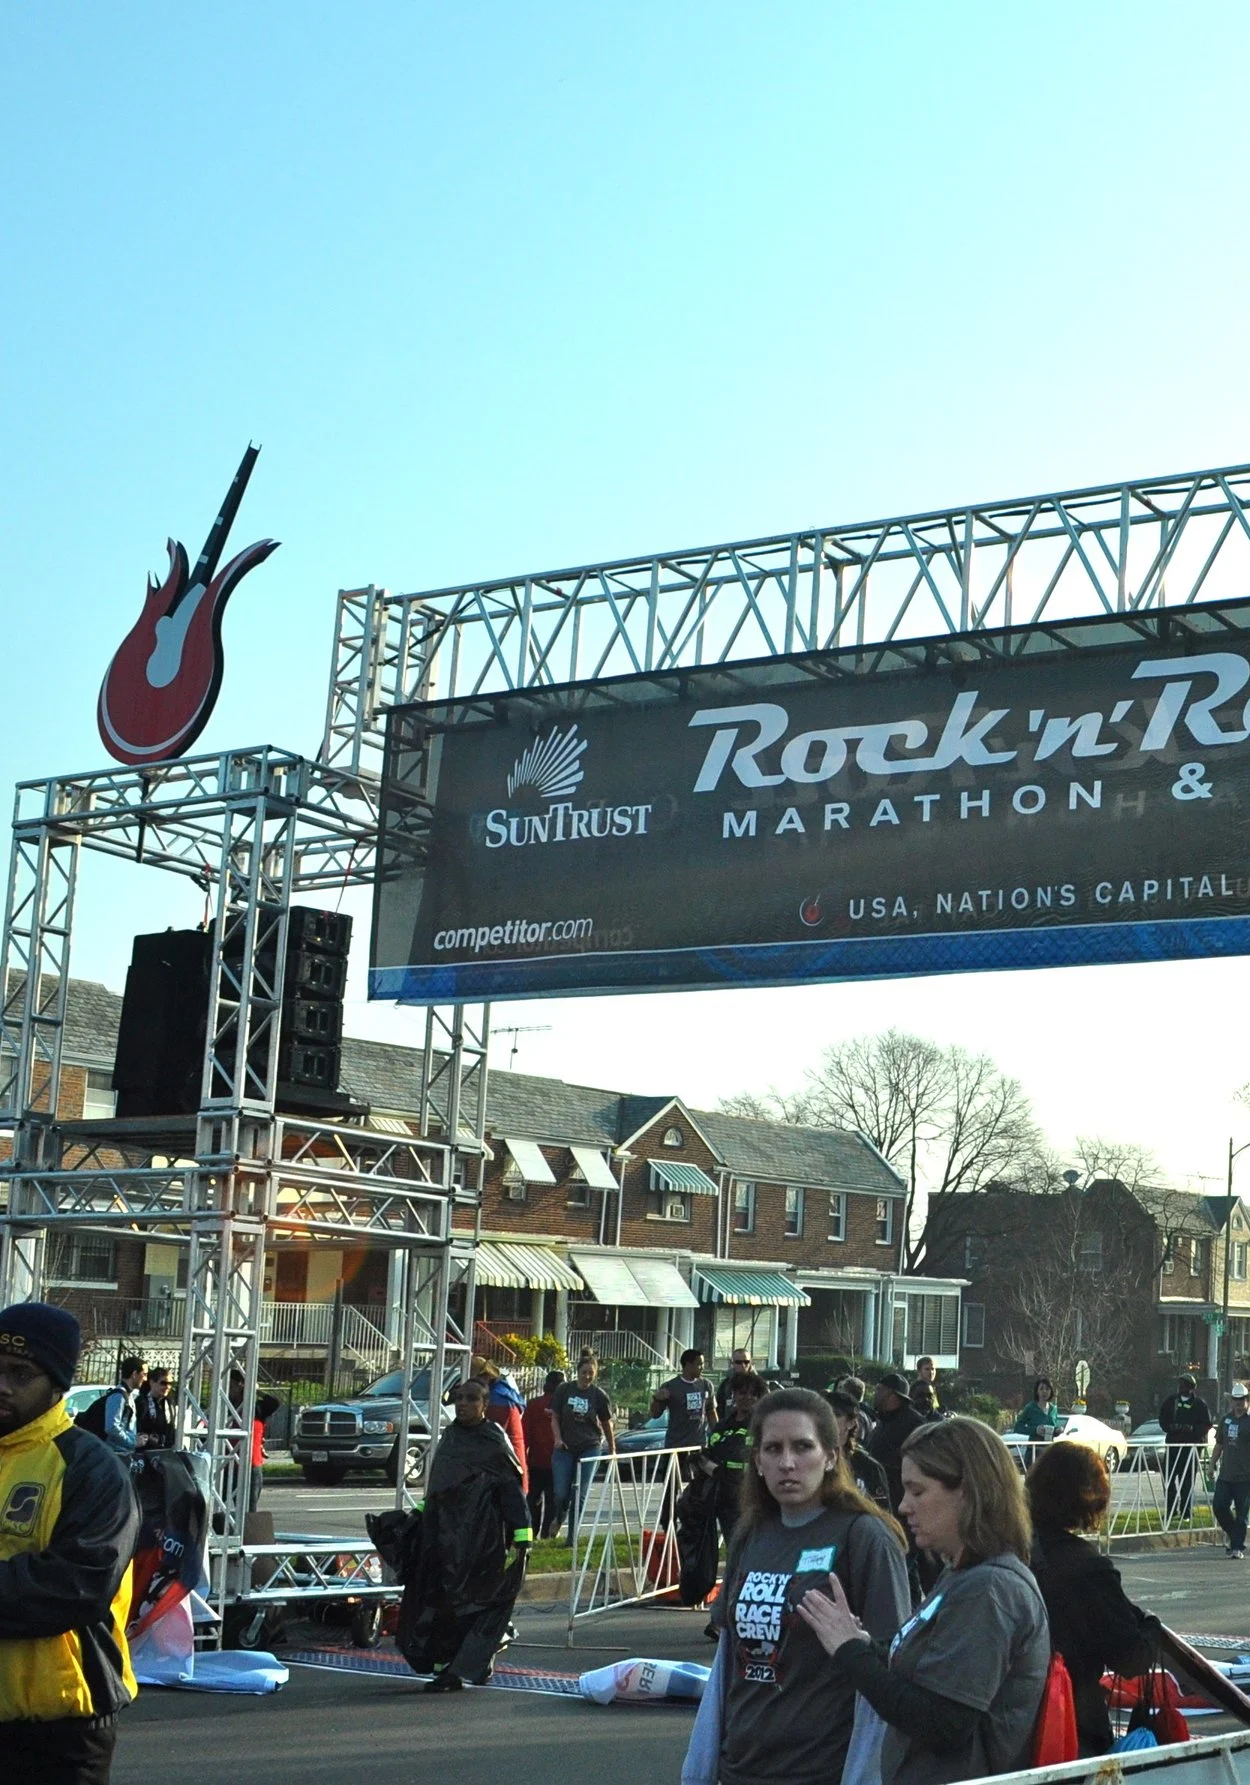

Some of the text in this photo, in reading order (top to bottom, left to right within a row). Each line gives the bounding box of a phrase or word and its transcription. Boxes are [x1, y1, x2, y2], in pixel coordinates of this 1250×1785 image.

[721, 779, 1103, 839] MARATHON
[1170, 761, 1214, 802] &
[848, 873, 1235, 921] USA, NATION'S CAPITAL
[432, 915, 595, 952] competitor.com
[738, 1581, 787, 1604] ROLL
[734, 1602, 783, 1625] RACE
[735, 1621, 782, 1642] CREW
[744, 1662, 777, 1683] 2012
